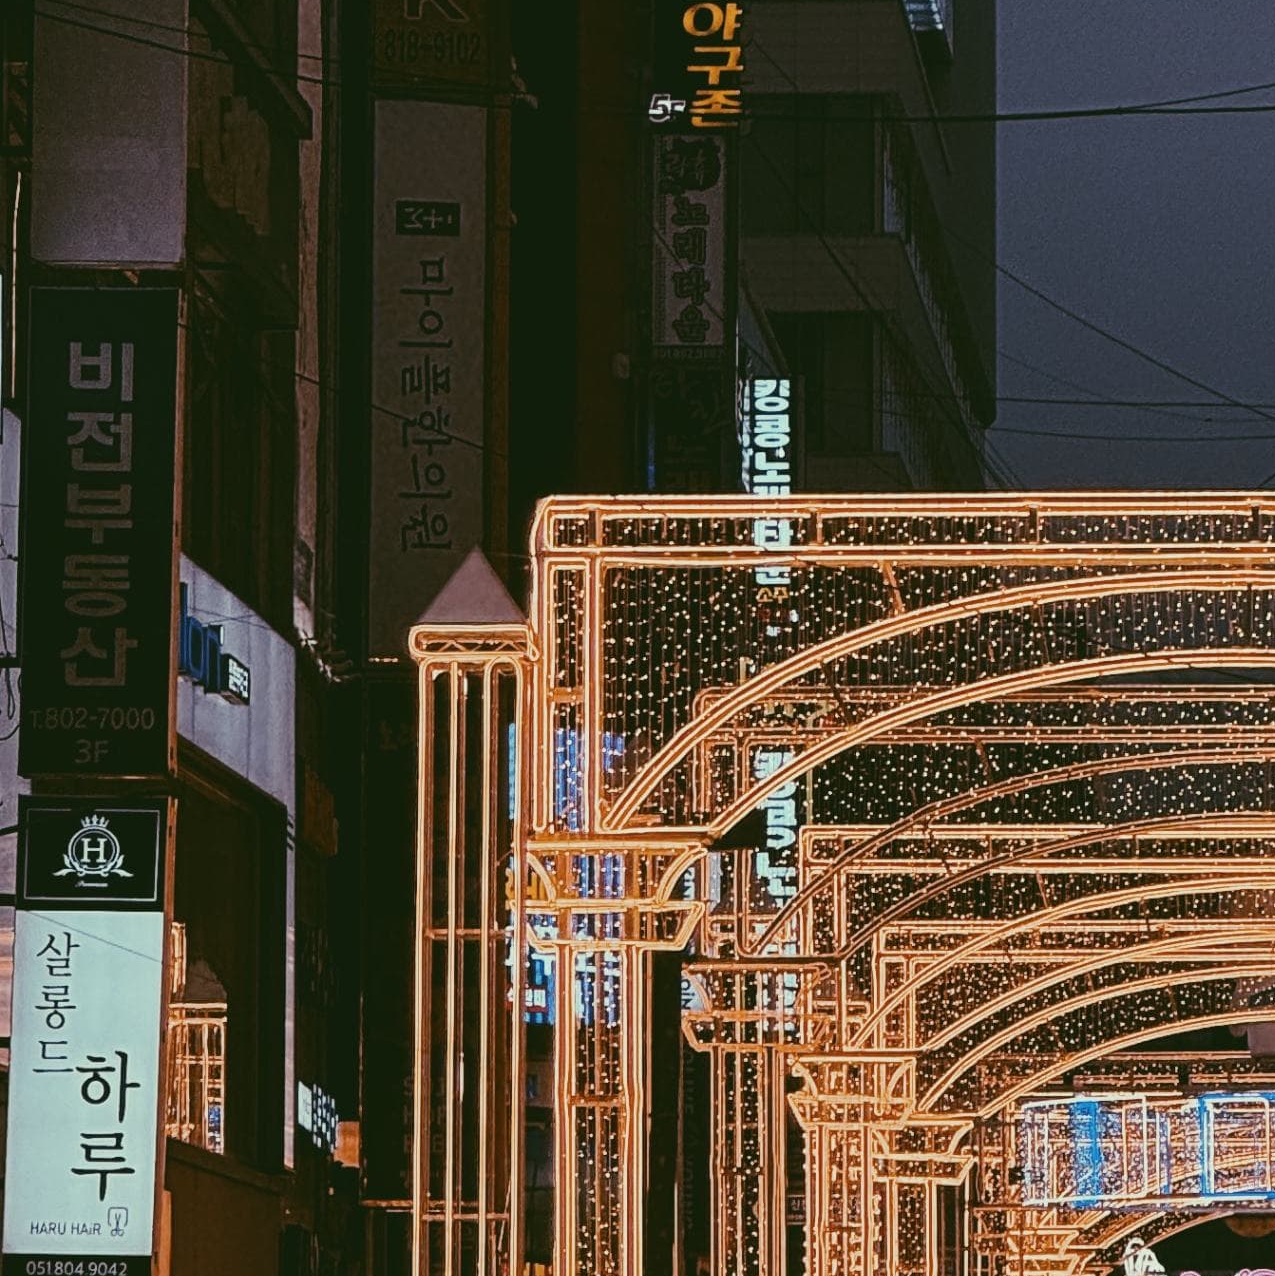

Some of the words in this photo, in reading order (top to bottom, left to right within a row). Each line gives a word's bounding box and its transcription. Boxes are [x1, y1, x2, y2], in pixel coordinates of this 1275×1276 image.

[682, 2, 745, 128] 야구존
[400, 256, 454, 553] 마이플한의원
[60, 341, 138, 689] 비전부동산
[29, 707, 155, 731] T.802-7000
[73, 739, 111, 764] 3F
[33, 931, 80, 1074] 살롱드
[71, 1049, 142, 1203] 하루
[30, 1222, 67, 1236] HARU
